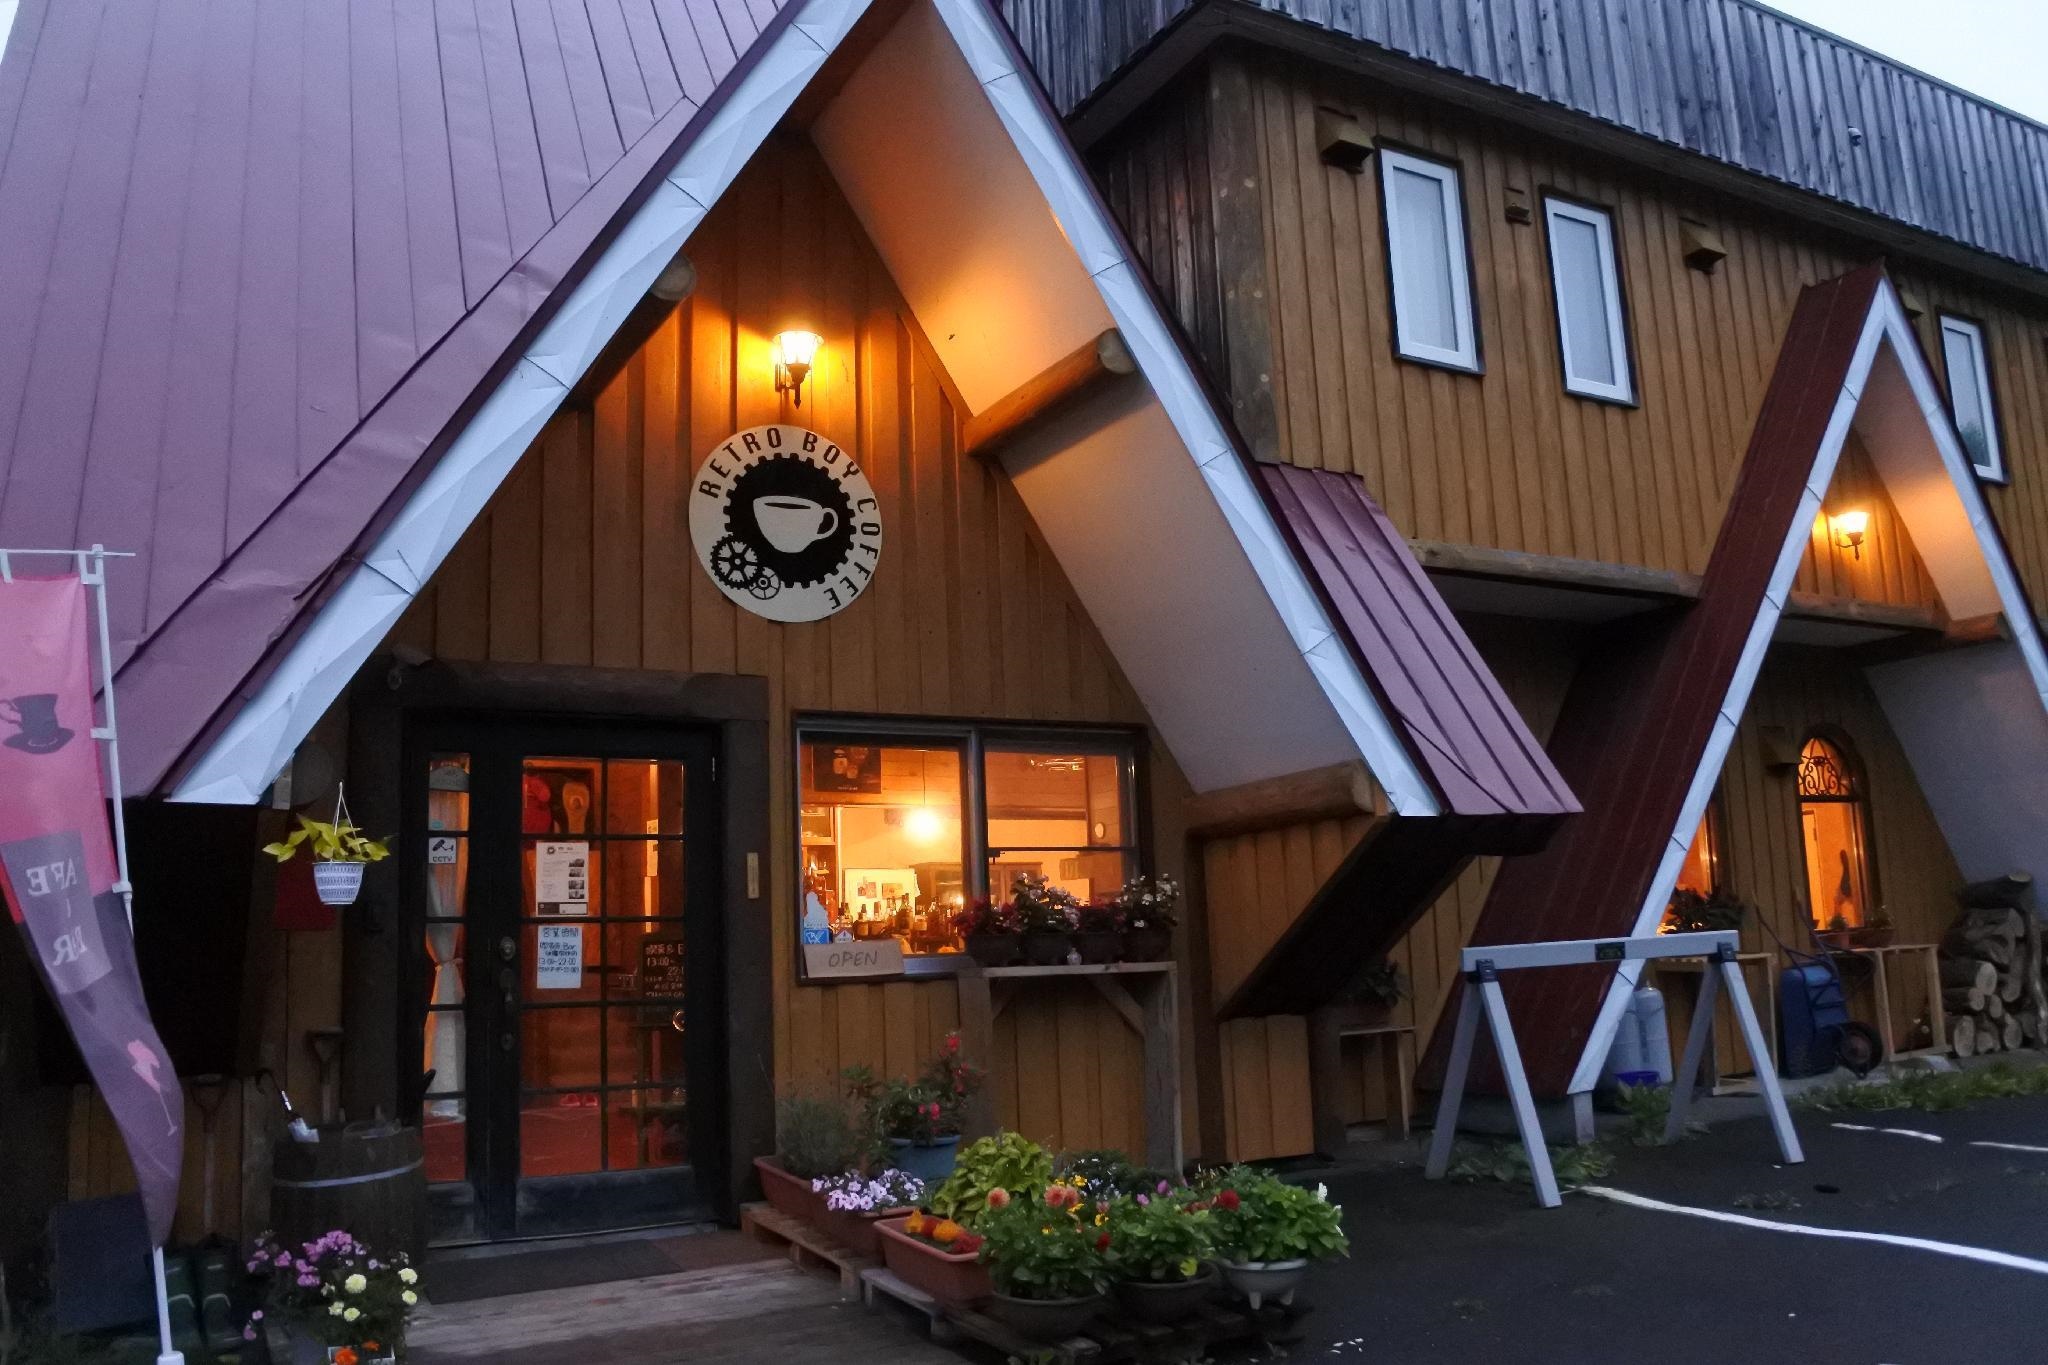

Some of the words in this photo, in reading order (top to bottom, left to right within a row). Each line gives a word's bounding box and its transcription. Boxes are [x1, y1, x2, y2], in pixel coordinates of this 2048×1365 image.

[698, 427, 782, 499] RETRO
[802, 431, 861, 479] BOY
[823, 497, 881, 610] COFFEE
[828, 950, 878, 968] OPEN
